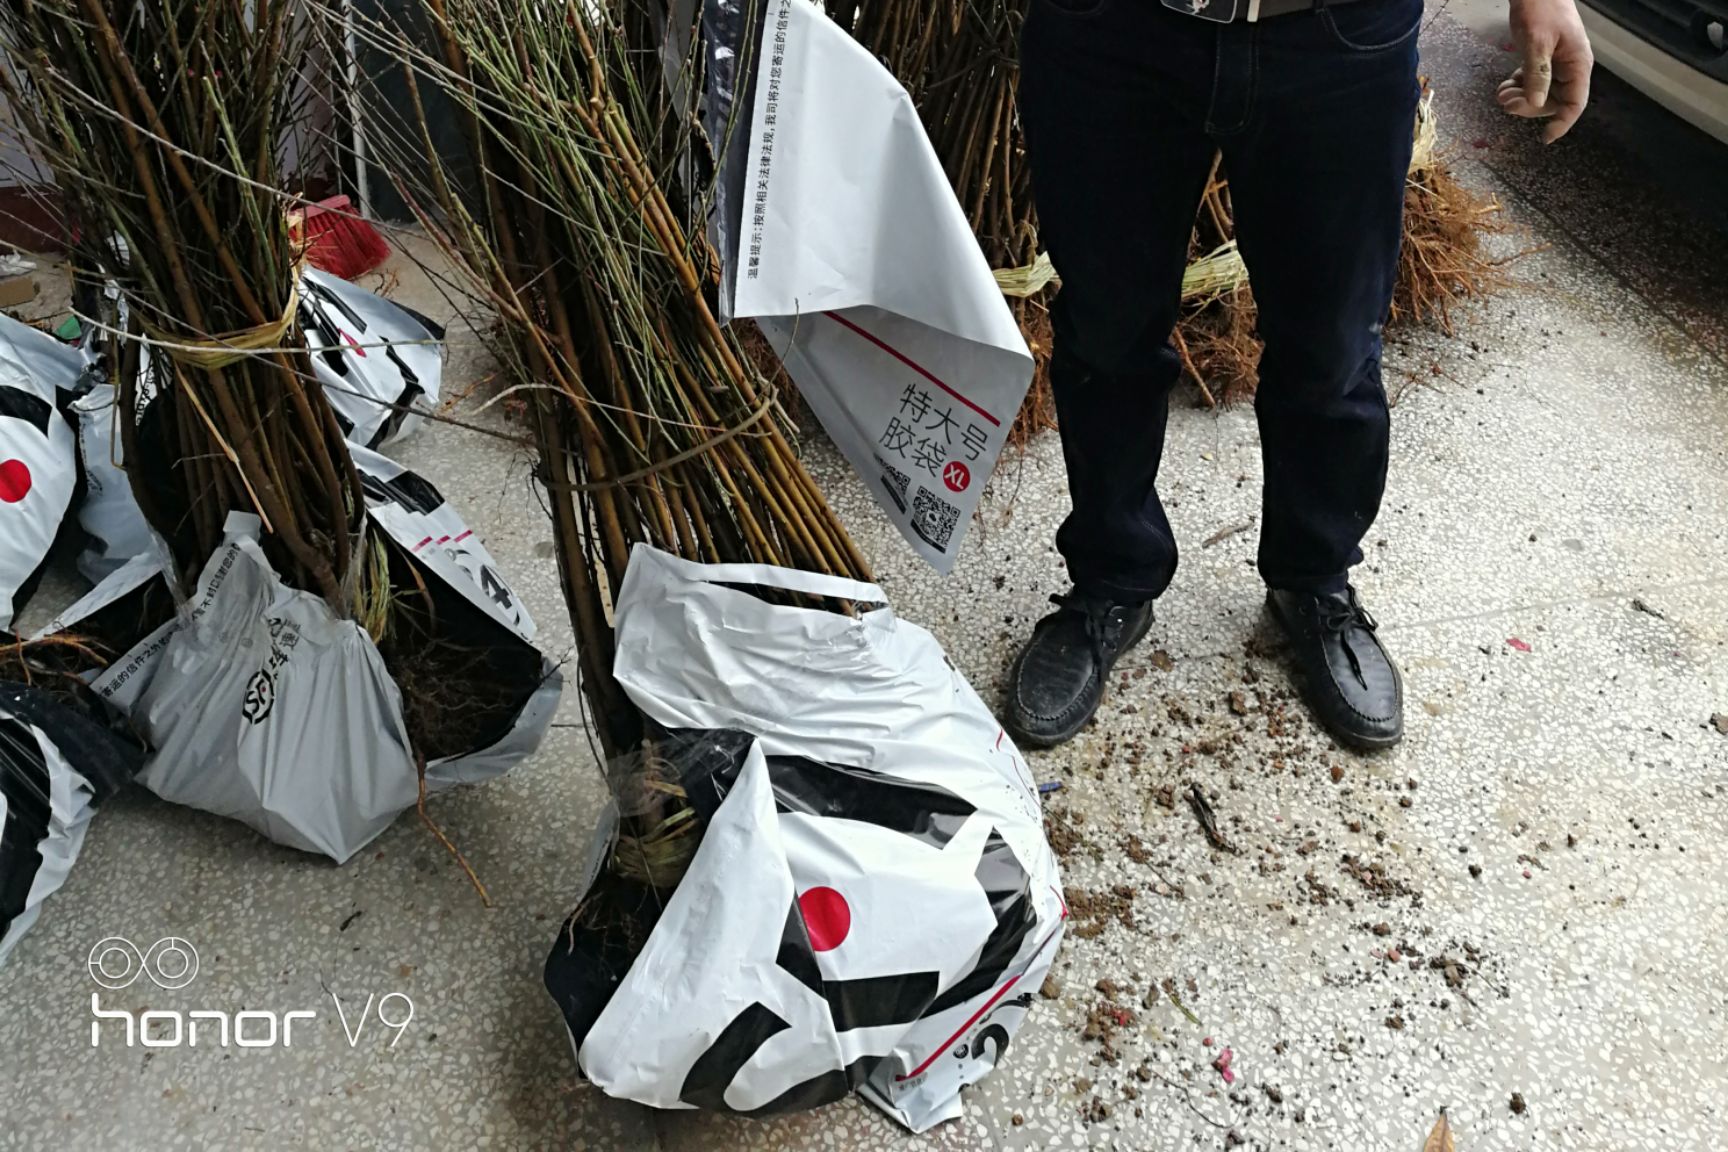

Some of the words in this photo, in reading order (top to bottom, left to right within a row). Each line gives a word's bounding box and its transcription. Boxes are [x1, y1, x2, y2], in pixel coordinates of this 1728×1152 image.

[879, 416, 947, 478] 胶袋
[900, 383, 988, 461] 特大号
[944, 463, 964, 490] XL
